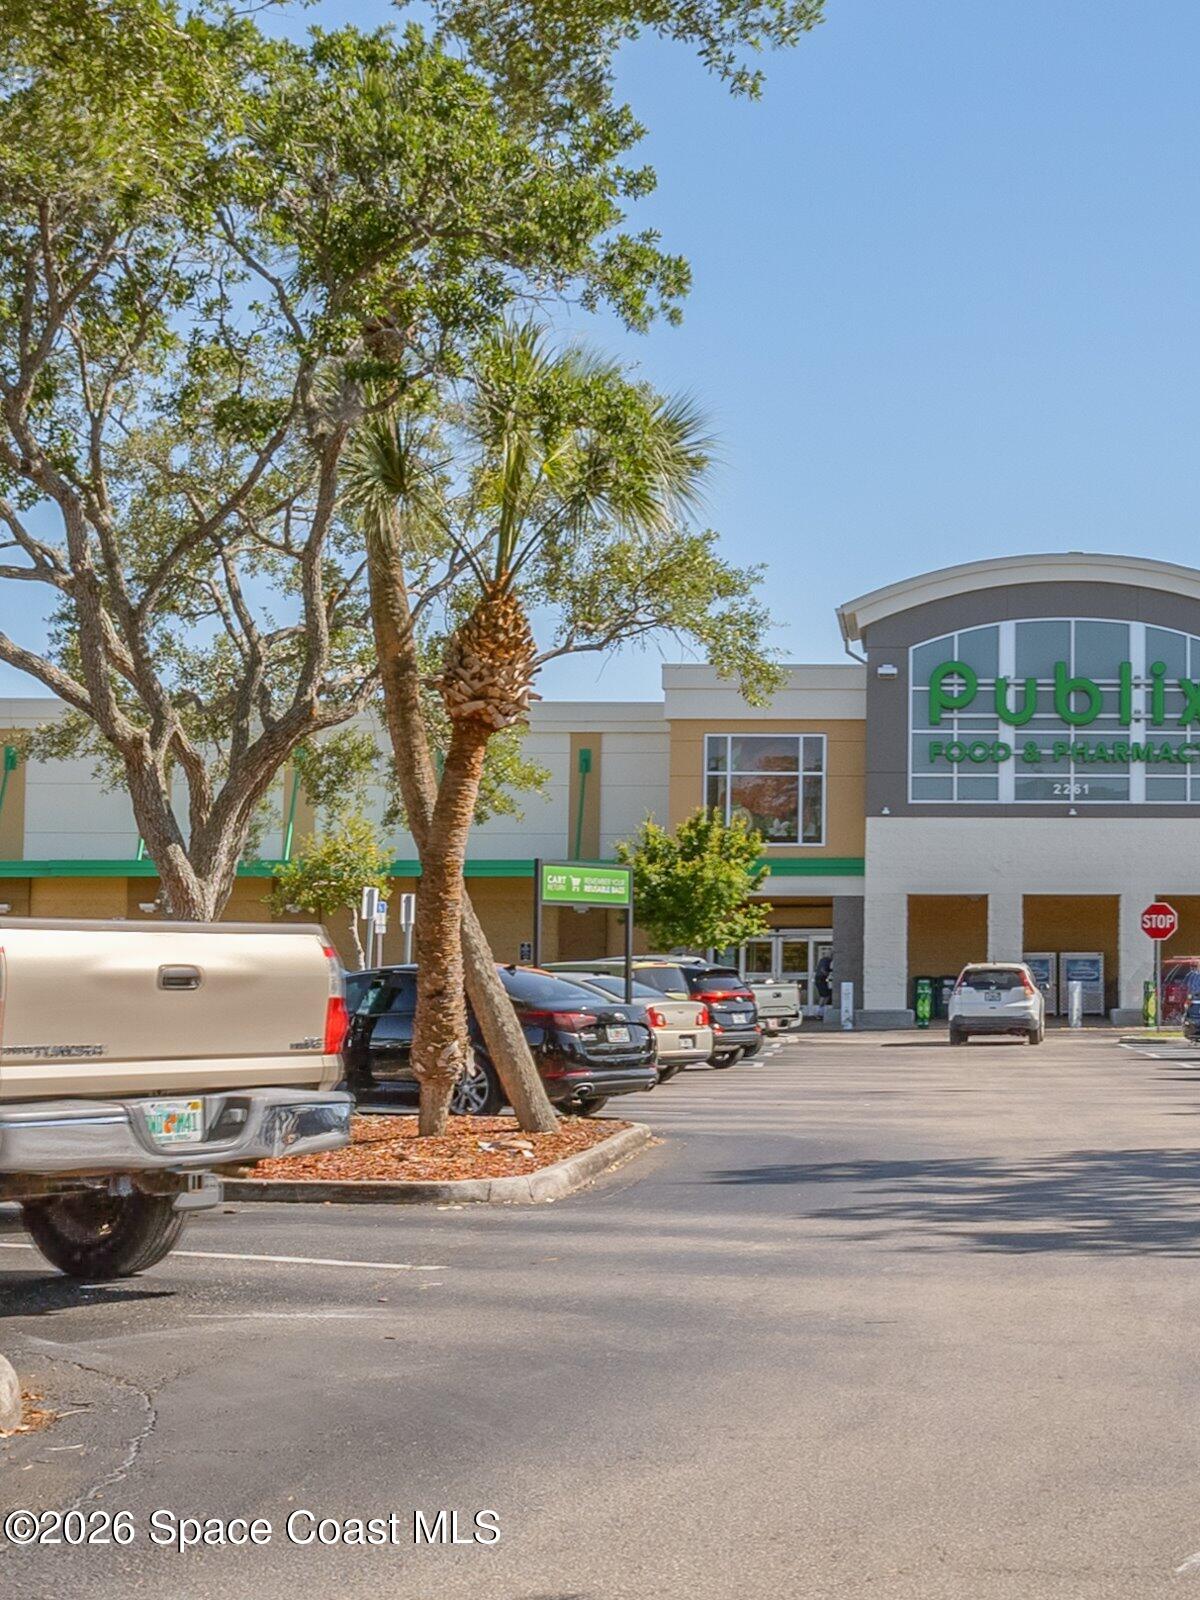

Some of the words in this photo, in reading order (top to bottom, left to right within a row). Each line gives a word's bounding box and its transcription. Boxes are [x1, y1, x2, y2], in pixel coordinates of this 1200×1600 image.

[928, 741, 1012, 763] FOOD
[1022, 741, 1042, 763] &
[1053, 784, 1089, 795] 2261
[547, 875, 567, 884] CART
[1142, 914, 1174, 929] STOP
